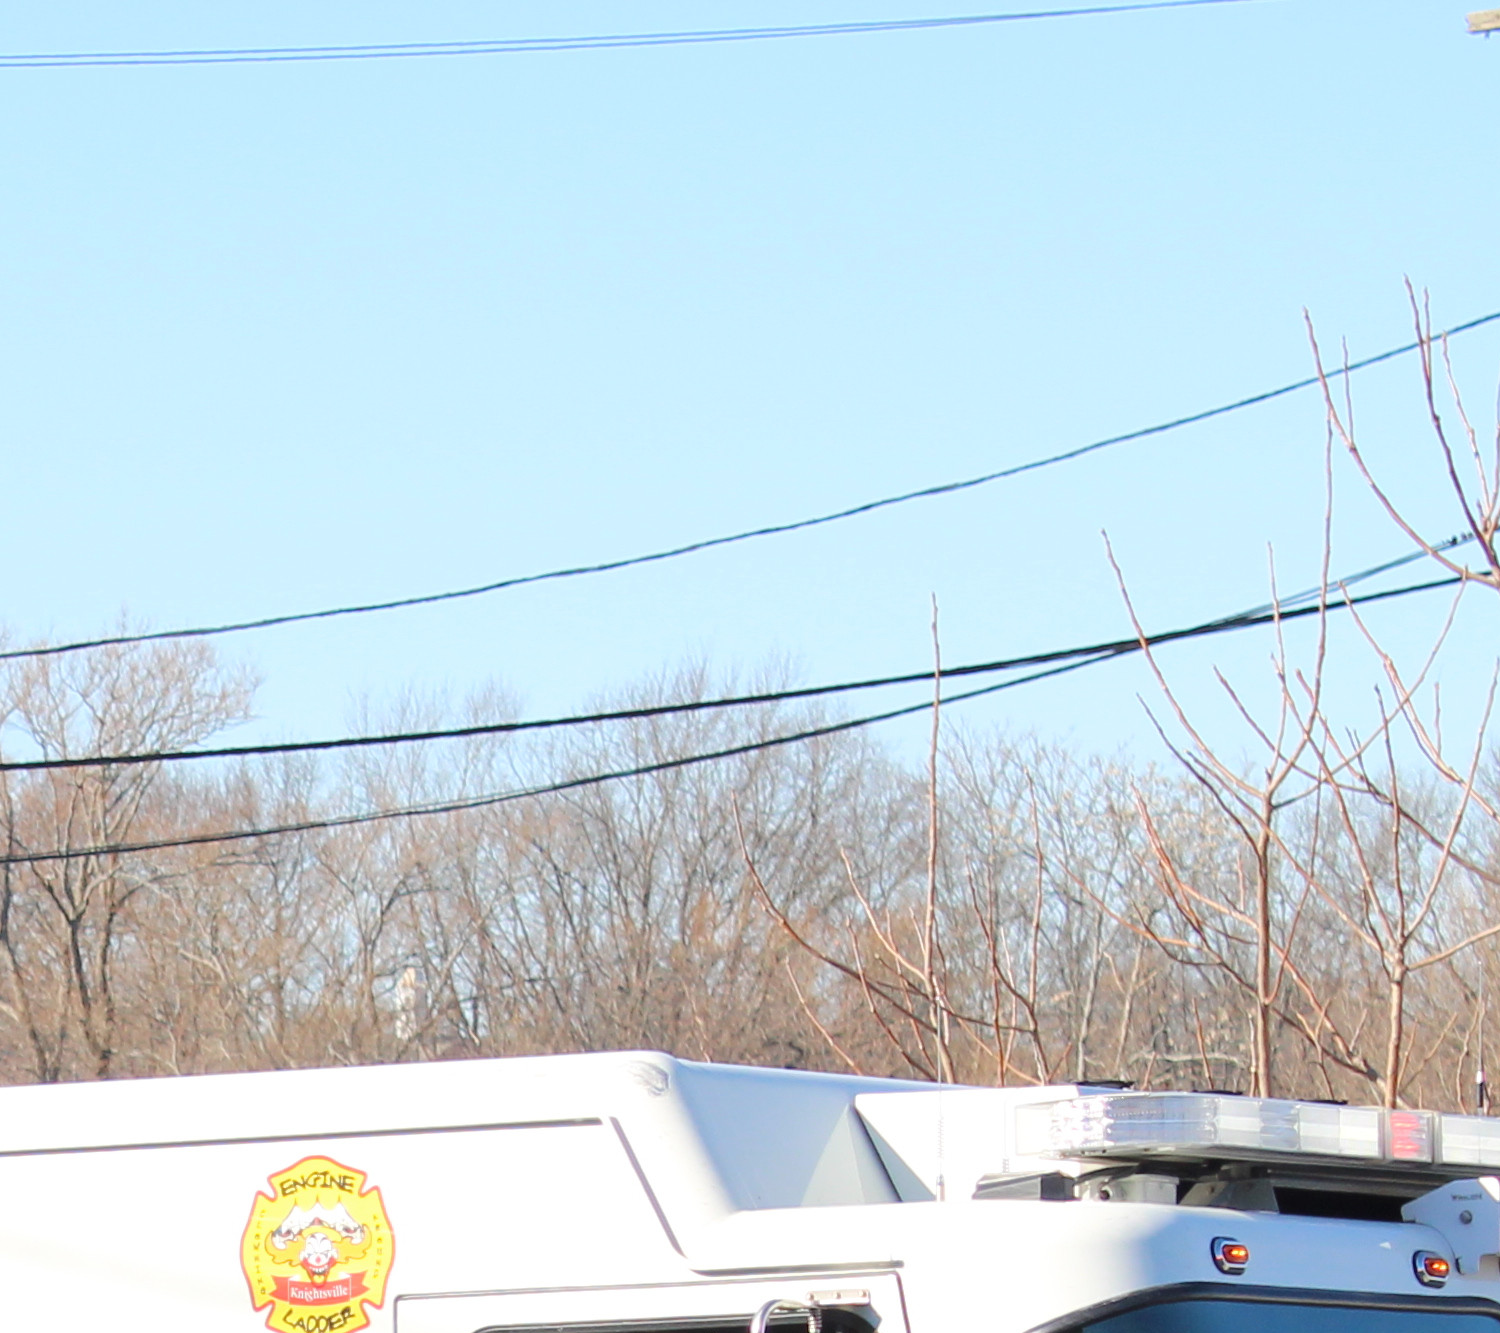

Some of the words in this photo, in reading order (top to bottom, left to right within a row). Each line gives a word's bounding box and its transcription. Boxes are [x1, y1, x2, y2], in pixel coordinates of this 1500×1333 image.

[280, 1172, 355, 1197] ENGINE
[291, 1284, 348, 1303] Knightsville
[282, 1306, 355, 1333] LADDER
